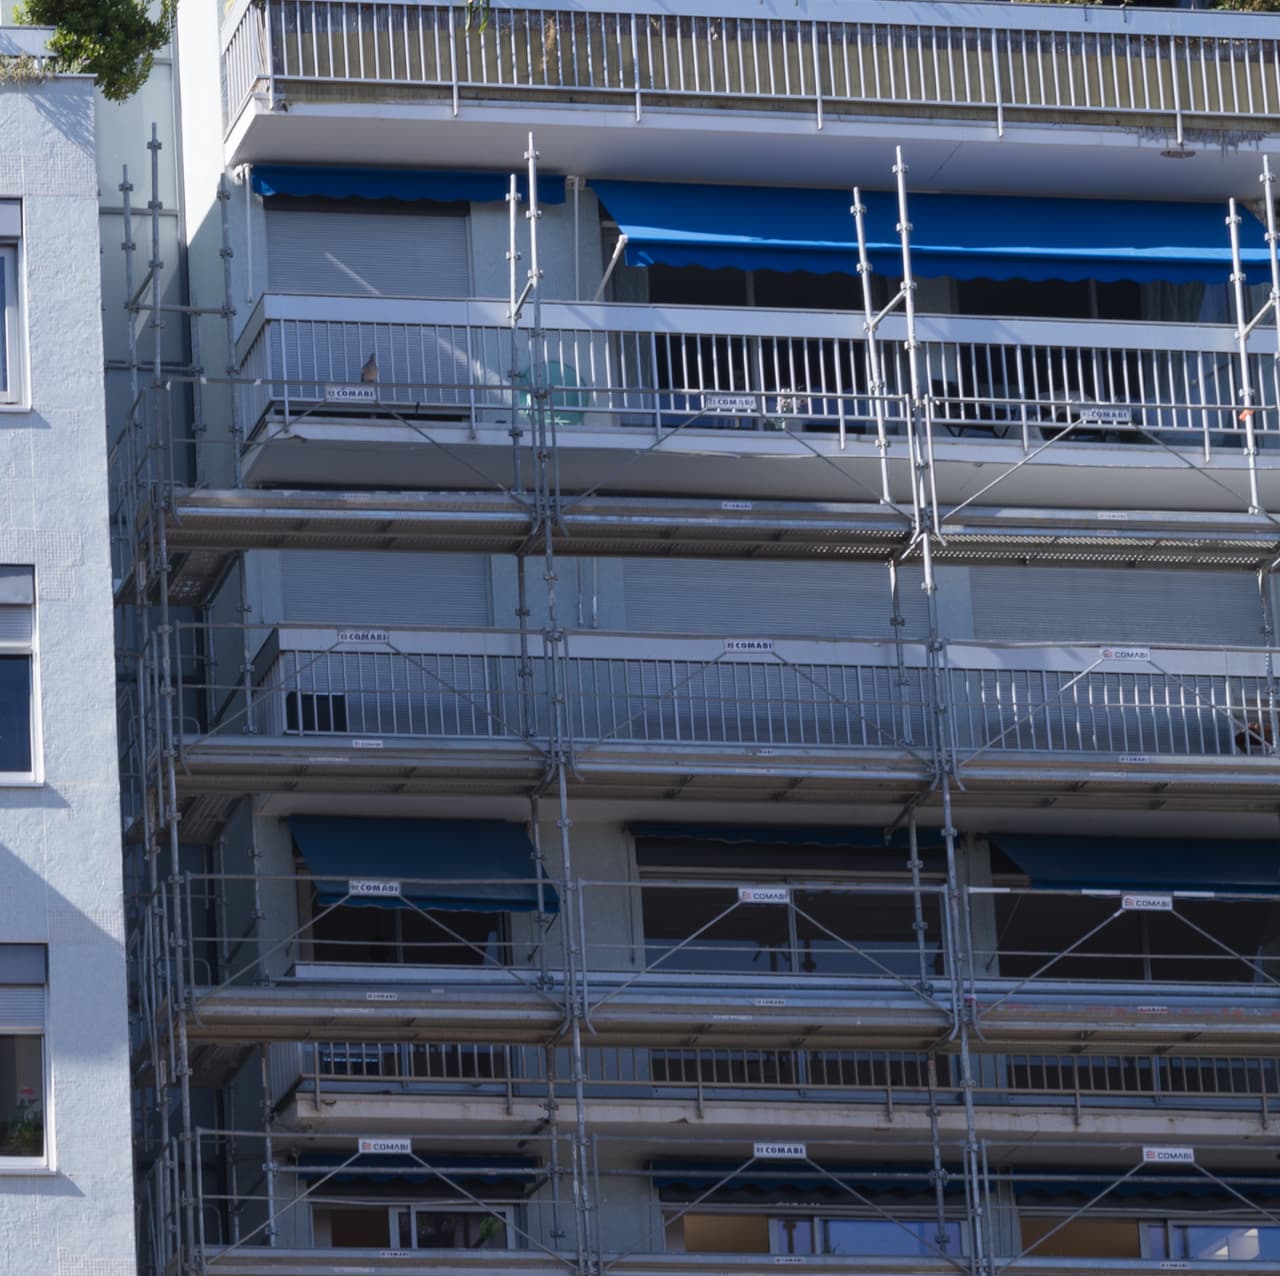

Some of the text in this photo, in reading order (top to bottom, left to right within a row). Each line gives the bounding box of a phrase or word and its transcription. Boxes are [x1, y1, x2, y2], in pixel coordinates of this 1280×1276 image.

[336, 390, 373, 398] COMABI
[735, 641, 772, 649] COMABI
[360, 884, 398, 893] COMABI
[753, 892, 788, 900] COMABI
[1136, 899, 1171, 908] COMABI
[373, 1143, 409, 1151] COMABI
[765, 1146, 803, 1154] COMABI
[1157, 1152, 1192, 1160] COMABI
